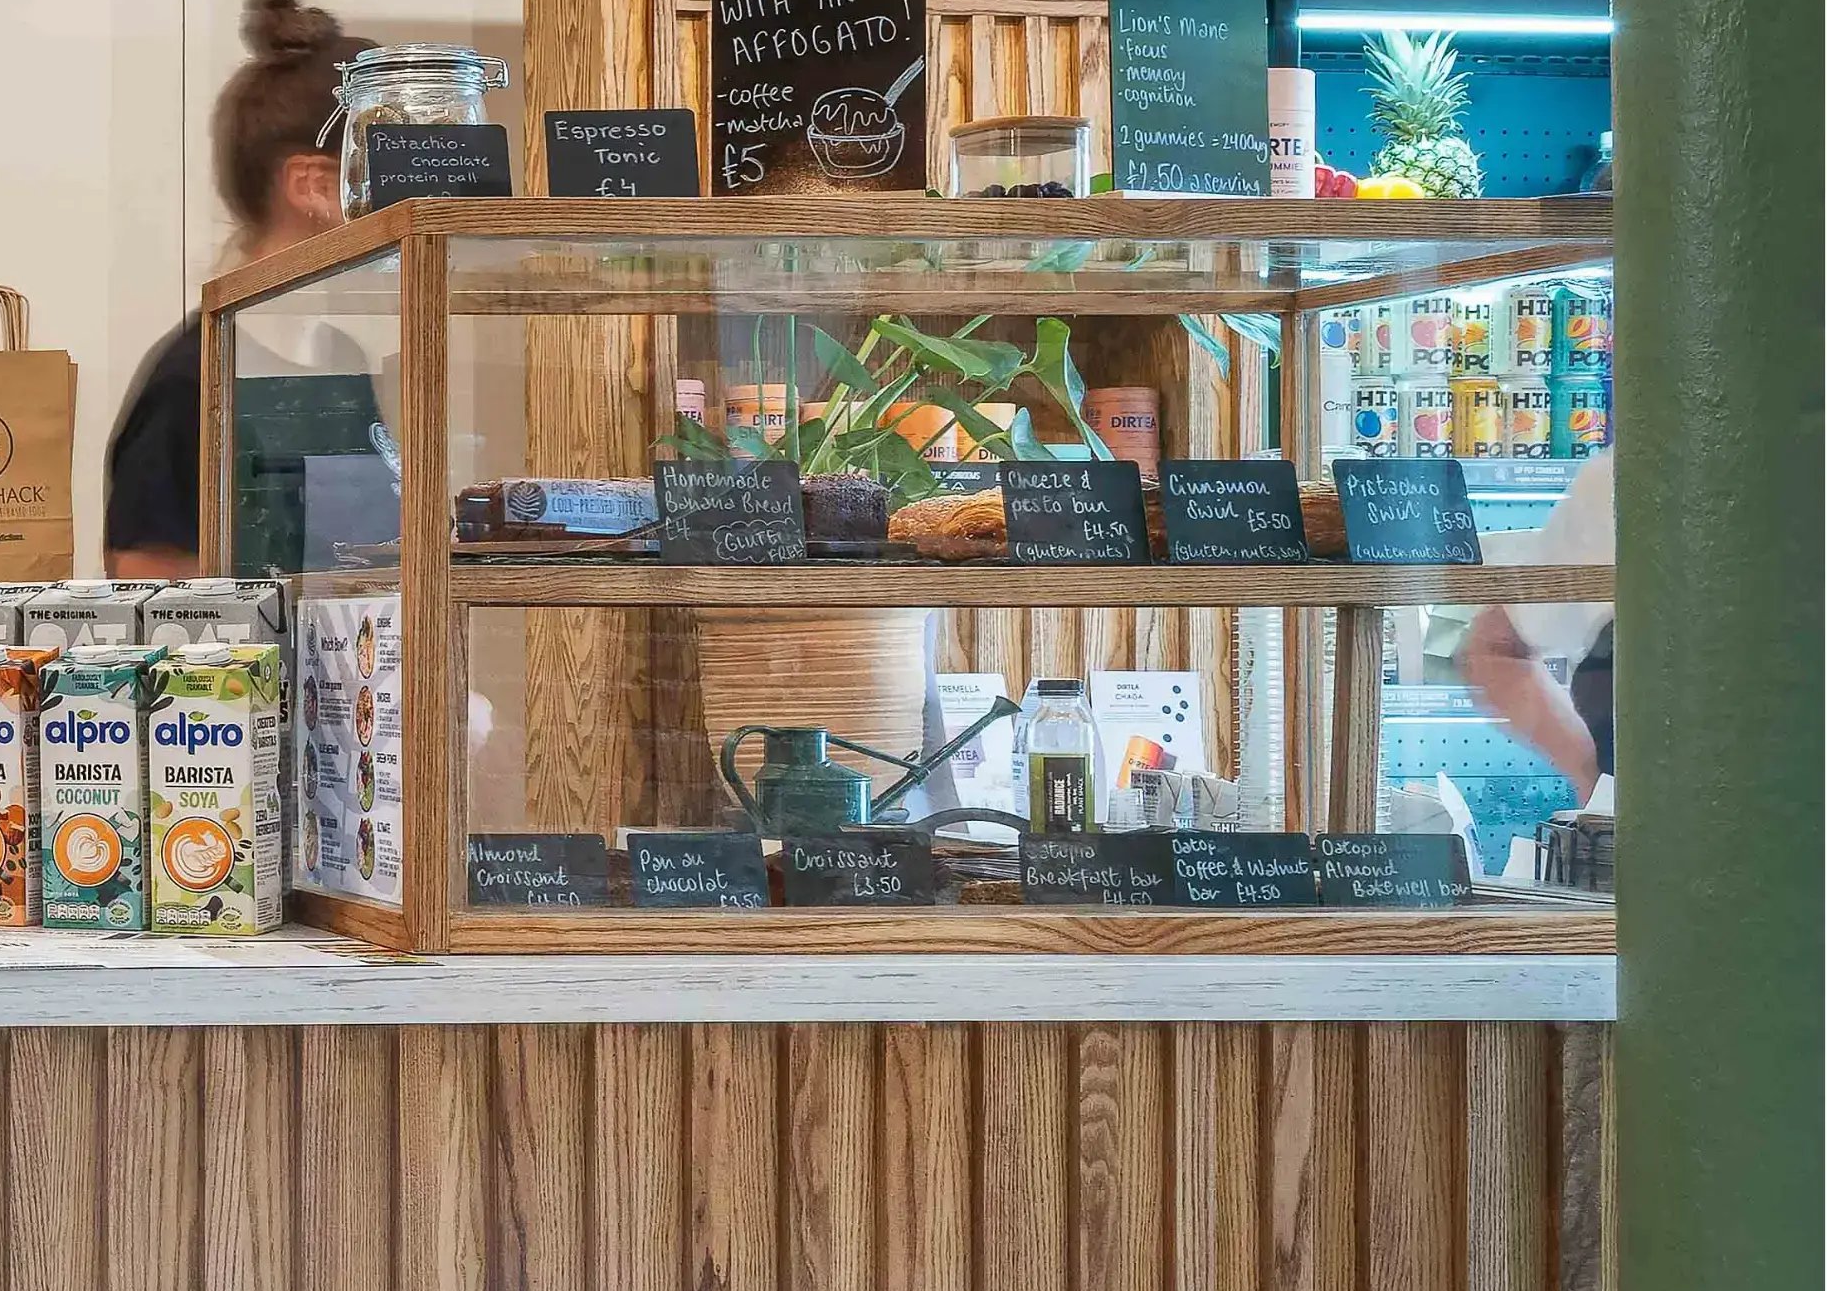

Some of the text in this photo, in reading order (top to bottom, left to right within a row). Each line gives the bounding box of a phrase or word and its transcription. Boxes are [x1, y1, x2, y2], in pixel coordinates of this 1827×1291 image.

[1119, 9, 1171, 35] Lion's
[554, 121, 666, 144] Espresso
[594, 142, 661, 165] Tonic
[722, 143, 766, 189] £5
[664, 467, 772, 490] Homemade
[1170, 473, 1271, 496] Cinnamon
[665, 492, 793, 514] Banana Bread
[46, 710, 130, 752] alpro
[155, 712, 243, 754] alpro
[55, 764, 122, 781] BARISTA
[165, 766, 234, 784] BARISTA
[56, 789, 120, 805] COCONUT
[179, 792, 218, 808] SOYA
[794, 846, 897, 871] Croissant
